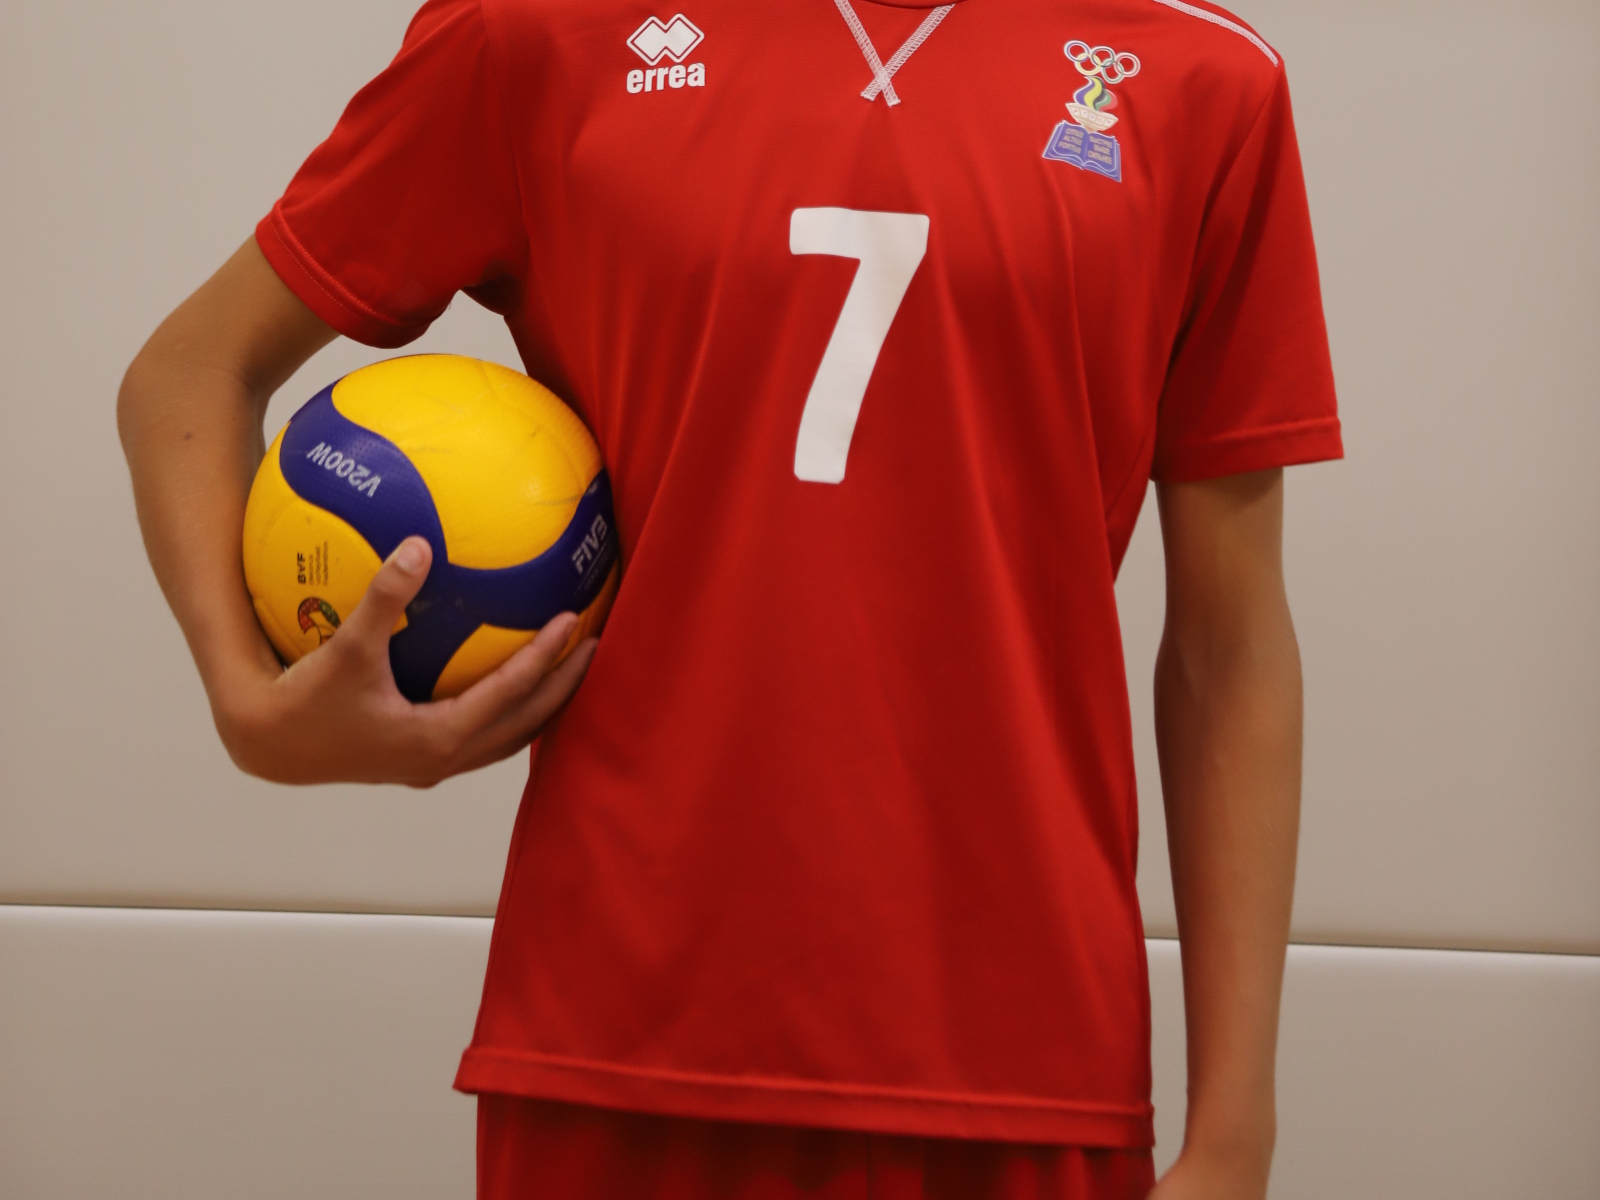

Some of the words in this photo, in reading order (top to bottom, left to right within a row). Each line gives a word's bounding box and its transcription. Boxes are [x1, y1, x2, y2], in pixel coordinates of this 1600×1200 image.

[627, 62, 705, 94] errea
[789, 207, 930, 485] 7
[306, 441, 381, 498] V200W
[297, 552, 306, 585] BVF
[571, 513, 607, 574] FIVB
